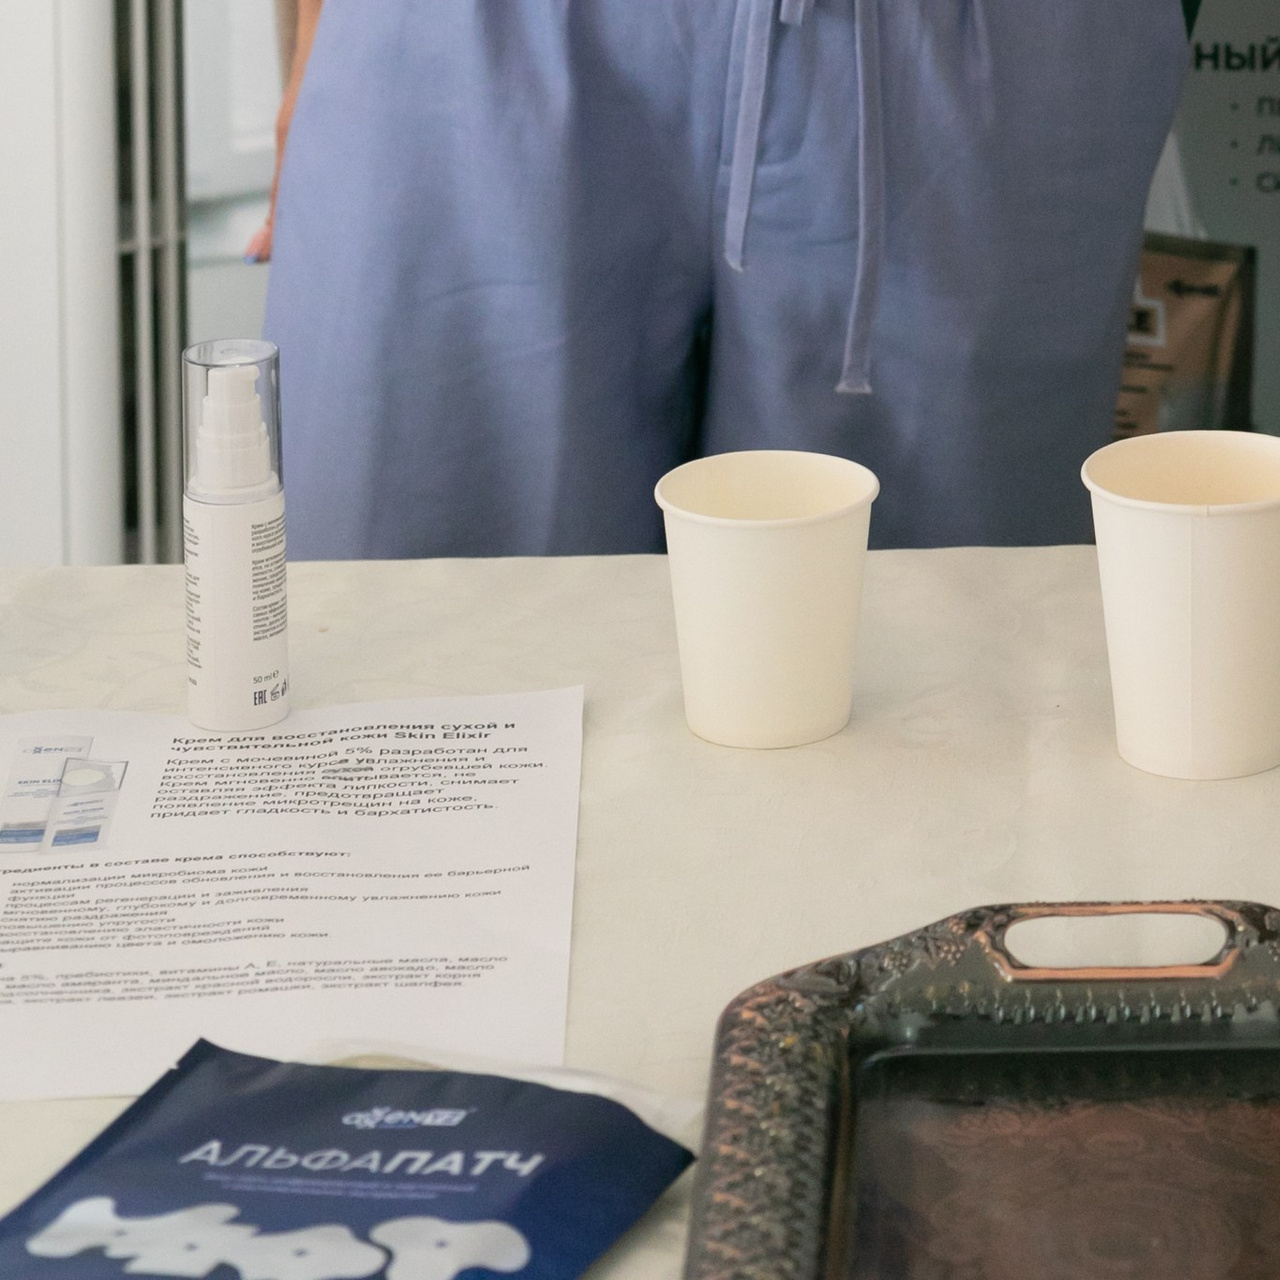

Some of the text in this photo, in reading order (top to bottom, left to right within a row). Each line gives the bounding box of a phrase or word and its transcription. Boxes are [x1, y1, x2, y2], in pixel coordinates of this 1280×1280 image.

[173, 737, 221, 745] Крем
[272, 724, 434, 740] восстановления
[441, 722, 497, 731] сухой
[171, 731, 492, 753] чувствительной кожи Skin Elixir
[167, 758, 214, 766] Крем
[236, 750, 338, 763] мочевиной
[345, 746, 373, 755] 5%
[380, 747, 488, 756] разработан
[493, 746, 528, 754] для
[164, 763, 292, 772] интенсивного
[355, 756, 468, 765] увлажнения
[162, 770, 316, 780] восстановления
[380, 764, 493, 772] огрубевшей
[214, 776, 315, 786] мгновенно
[157, 787, 245, 795] оставляя
[252, 782, 336, 792] эффекта
[294, 788, 445, 800] предотвращает
[153, 801, 256, 809] появление
[262, 799, 393, 808] микротрещин
[150, 809, 229, 819] придает
[235, 806, 330, 815] гладкость
[104, 857, 170, 867] составе
[174, 855, 223, 863] крема
[181, 872, 275, 884] обновления
[294, 871, 420, 879] восстановления
[179, 1138, 546, 1178] АЛЬФАПАТЧ
